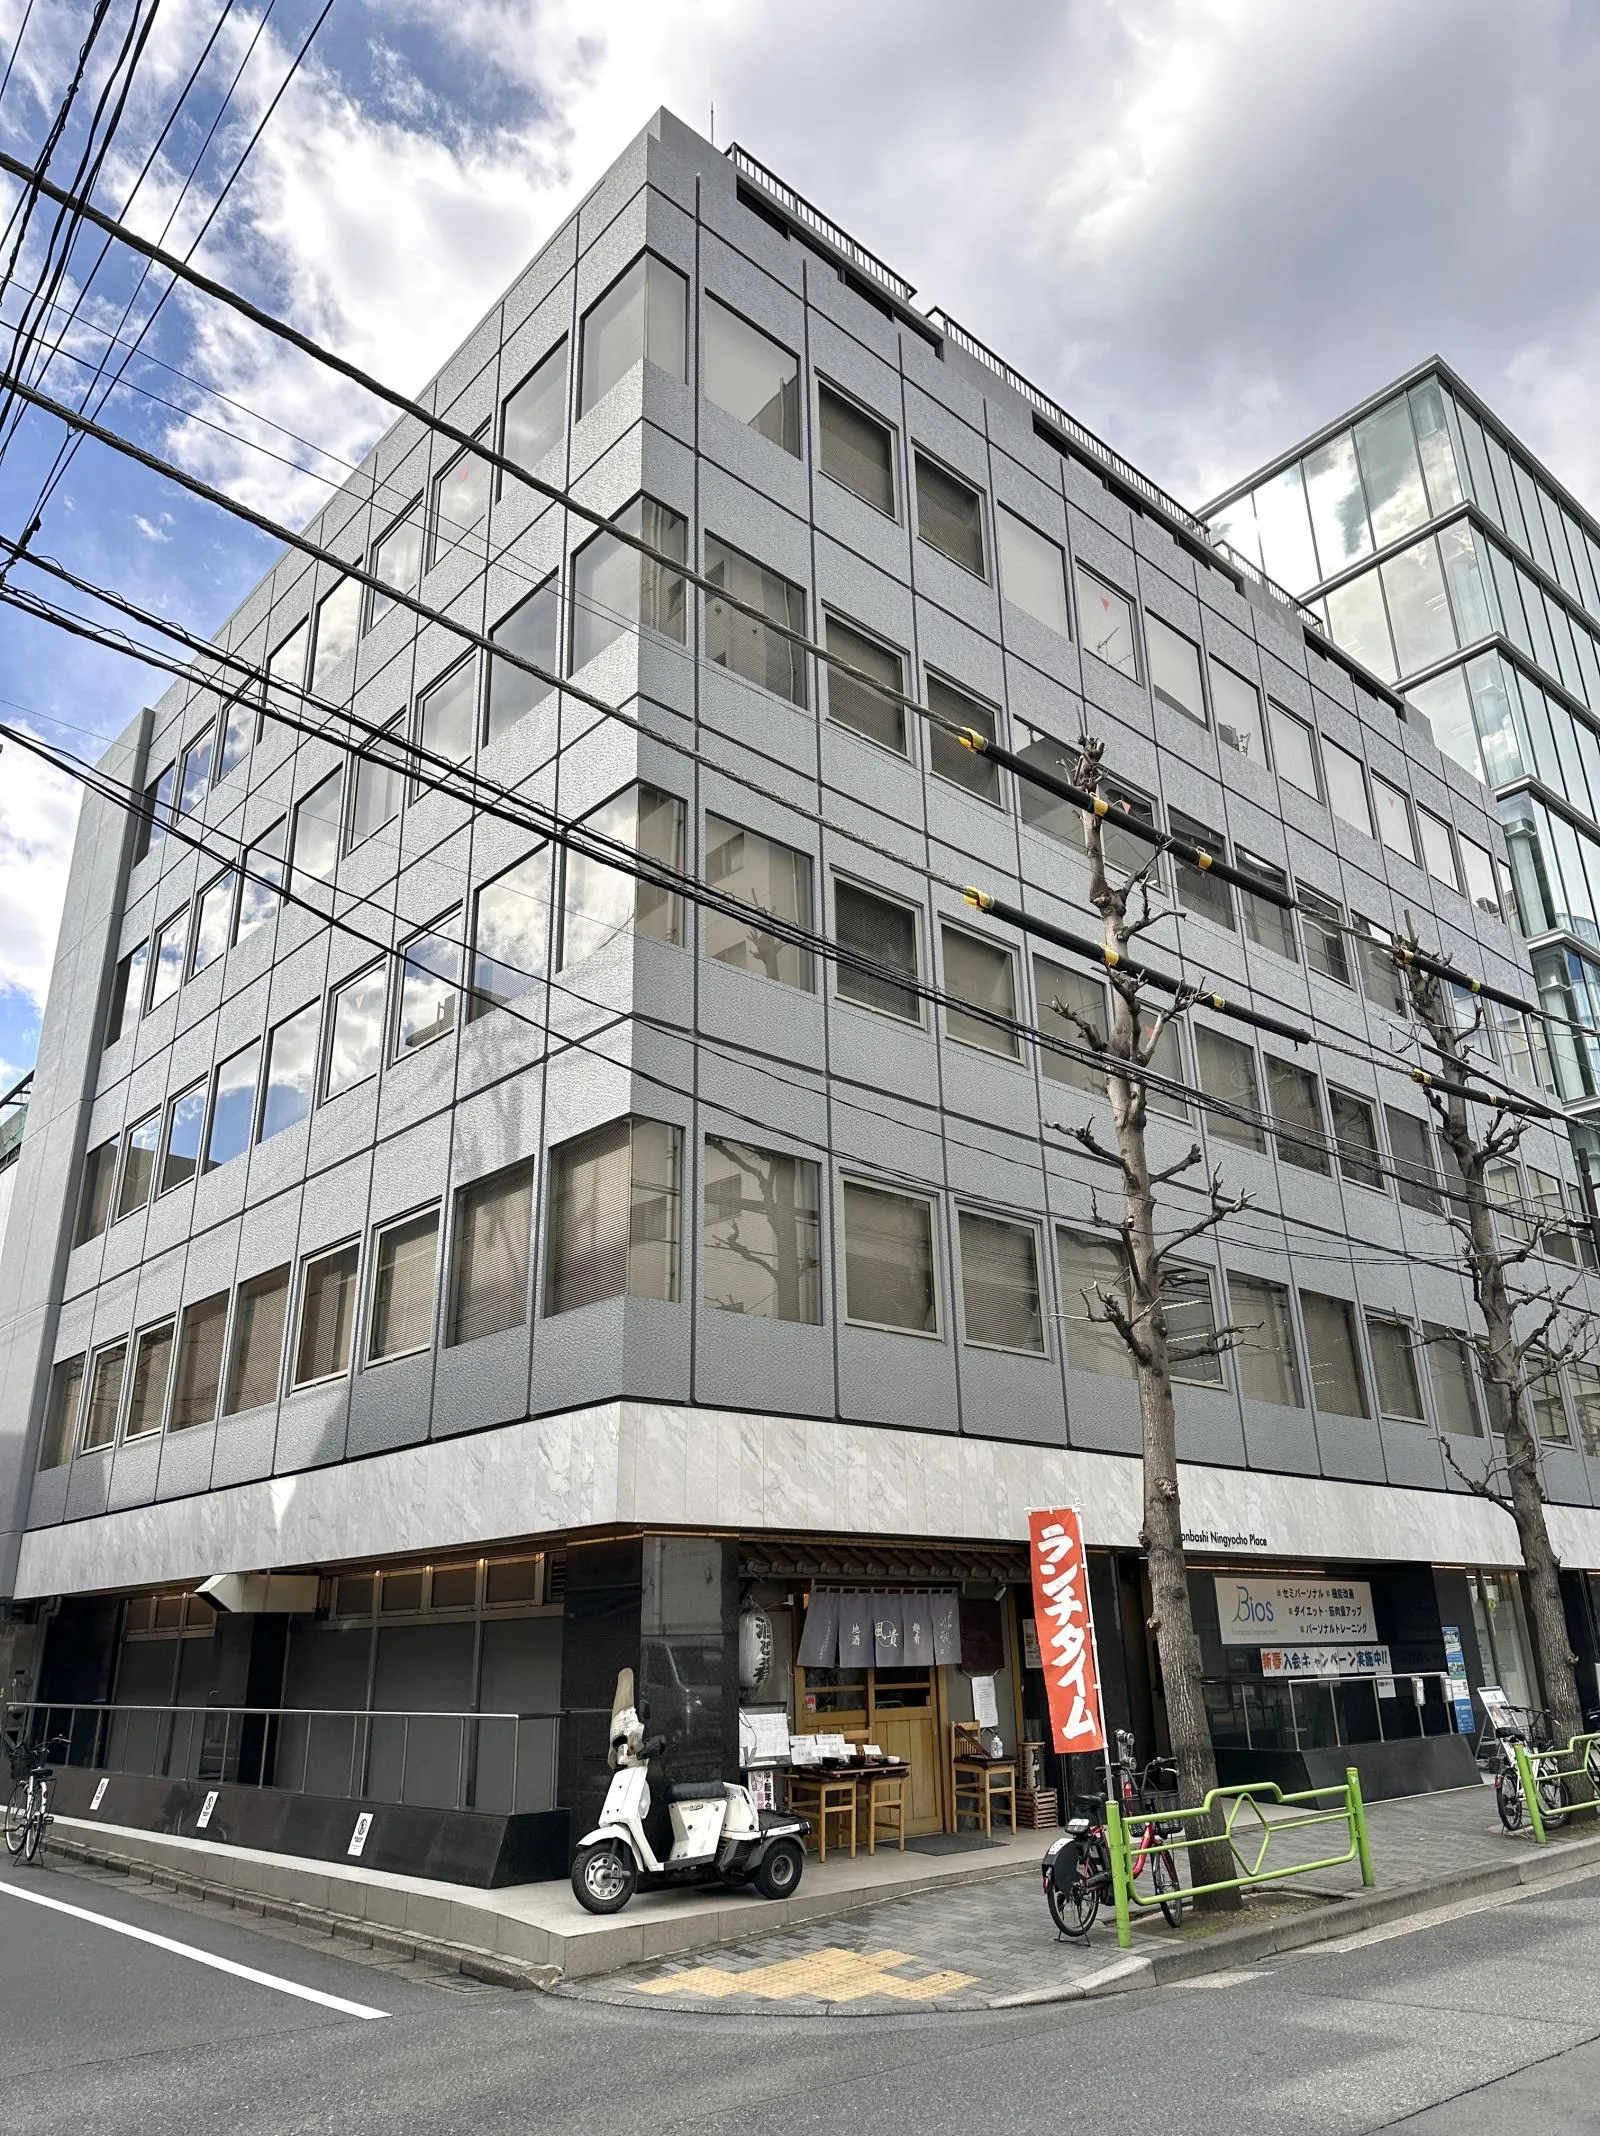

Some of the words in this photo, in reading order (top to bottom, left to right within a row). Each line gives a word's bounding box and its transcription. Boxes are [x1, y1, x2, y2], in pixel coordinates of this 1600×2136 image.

[1181, 1529, 1209, 1543] onbashi
[1210, 1531, 1248, 1547] Ningyocho
[1249, 1532, 1267, 1546] Place
[1232, 1585, 1274, 1623] Bios
[1037, 1523, 1097, 1739] ランチタイム
[1306, 1624, 1367, 1635] パーソナルトレーニング
